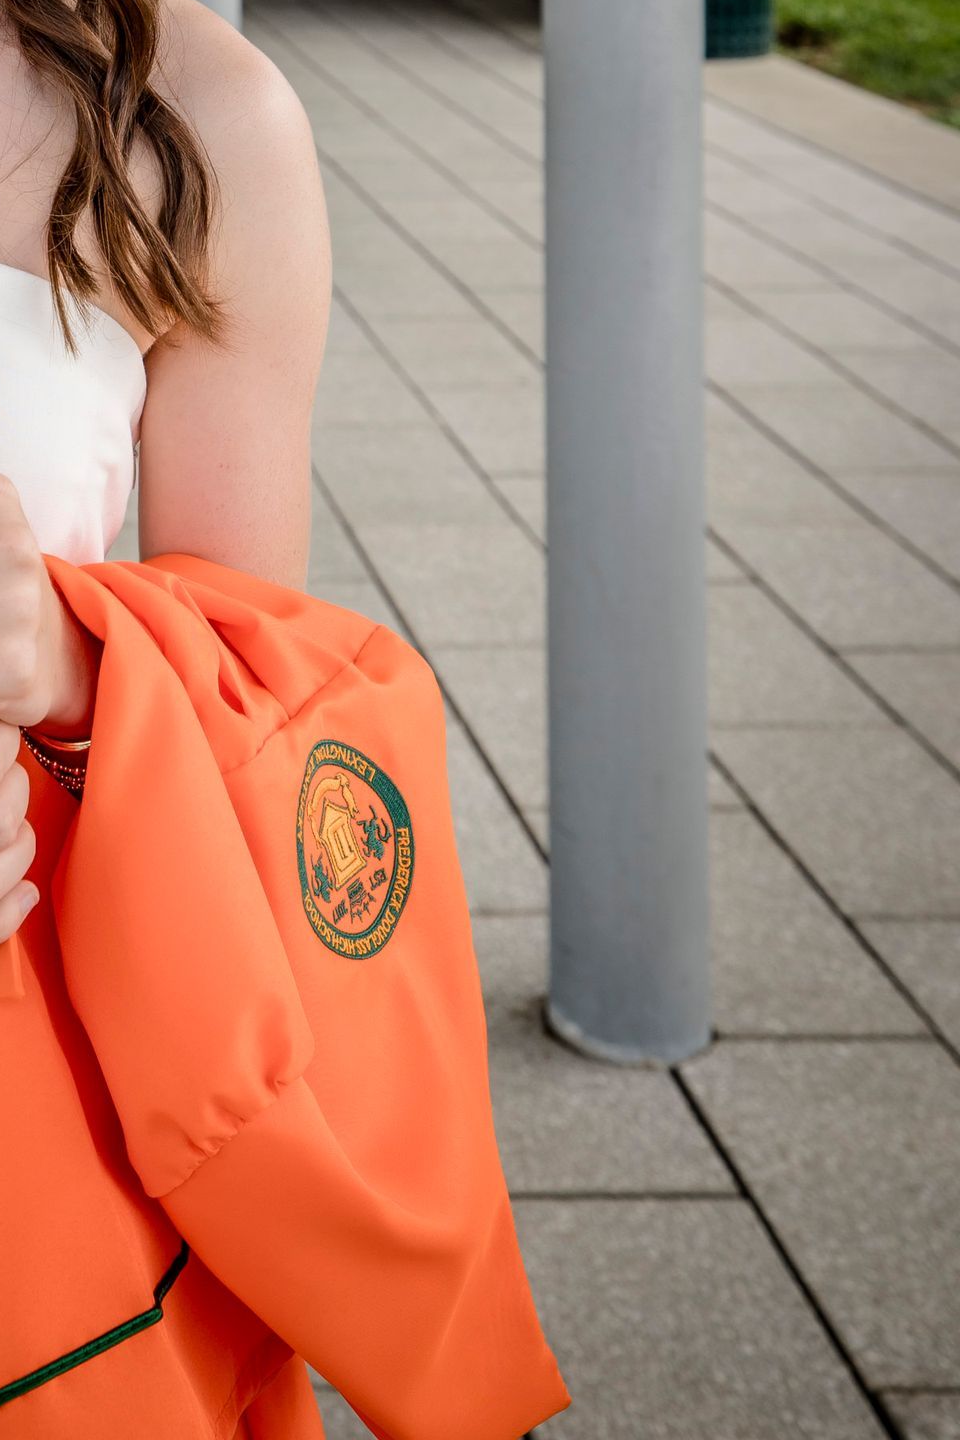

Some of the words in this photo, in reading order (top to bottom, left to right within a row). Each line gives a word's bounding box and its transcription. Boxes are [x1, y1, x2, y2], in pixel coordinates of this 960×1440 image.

[389, 827, 412, 912] FREDERICK
[305, 889, 333, 943] SCHOOL
[357, 909, 396, 955] DOUGLASS
[332, 931, 356, 956] HIGH
